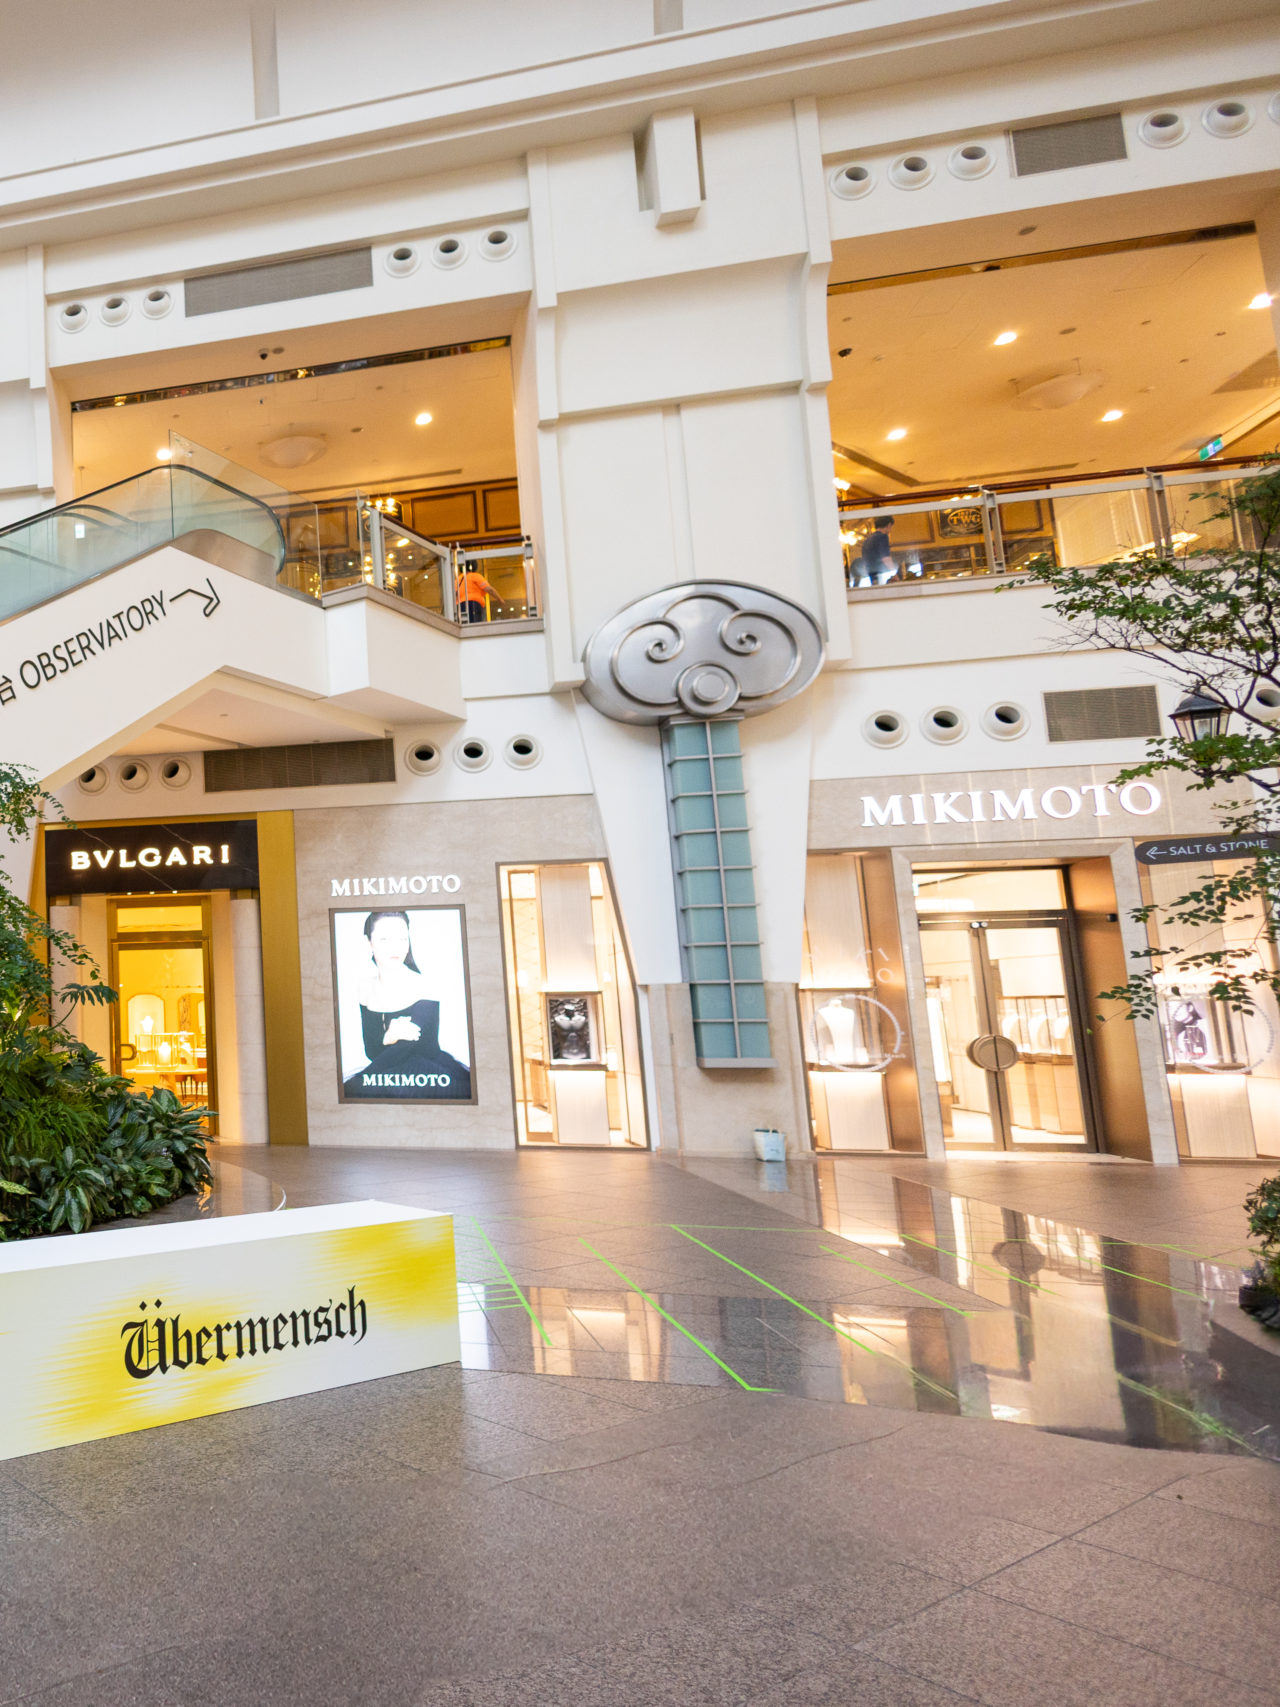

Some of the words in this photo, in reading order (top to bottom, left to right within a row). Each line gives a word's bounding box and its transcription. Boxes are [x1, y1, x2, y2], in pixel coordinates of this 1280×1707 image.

[19, 589, 167, 690] OBSERVATORY
[860, 782, 1162, 827] MIKIMOTO
[70, 844, 231, 870] BVLGARI
[1169, 844, 1202, 856] SALT
[1205, 843, 1217, 853] &
[1220, 839, 1269, 852] STONE
[330, 873, 462, 897] MIKIMOTO
[362, 1073, 451, 1087] MIKIMOTO
[120, 1285, 368, 1380] Übermensch
